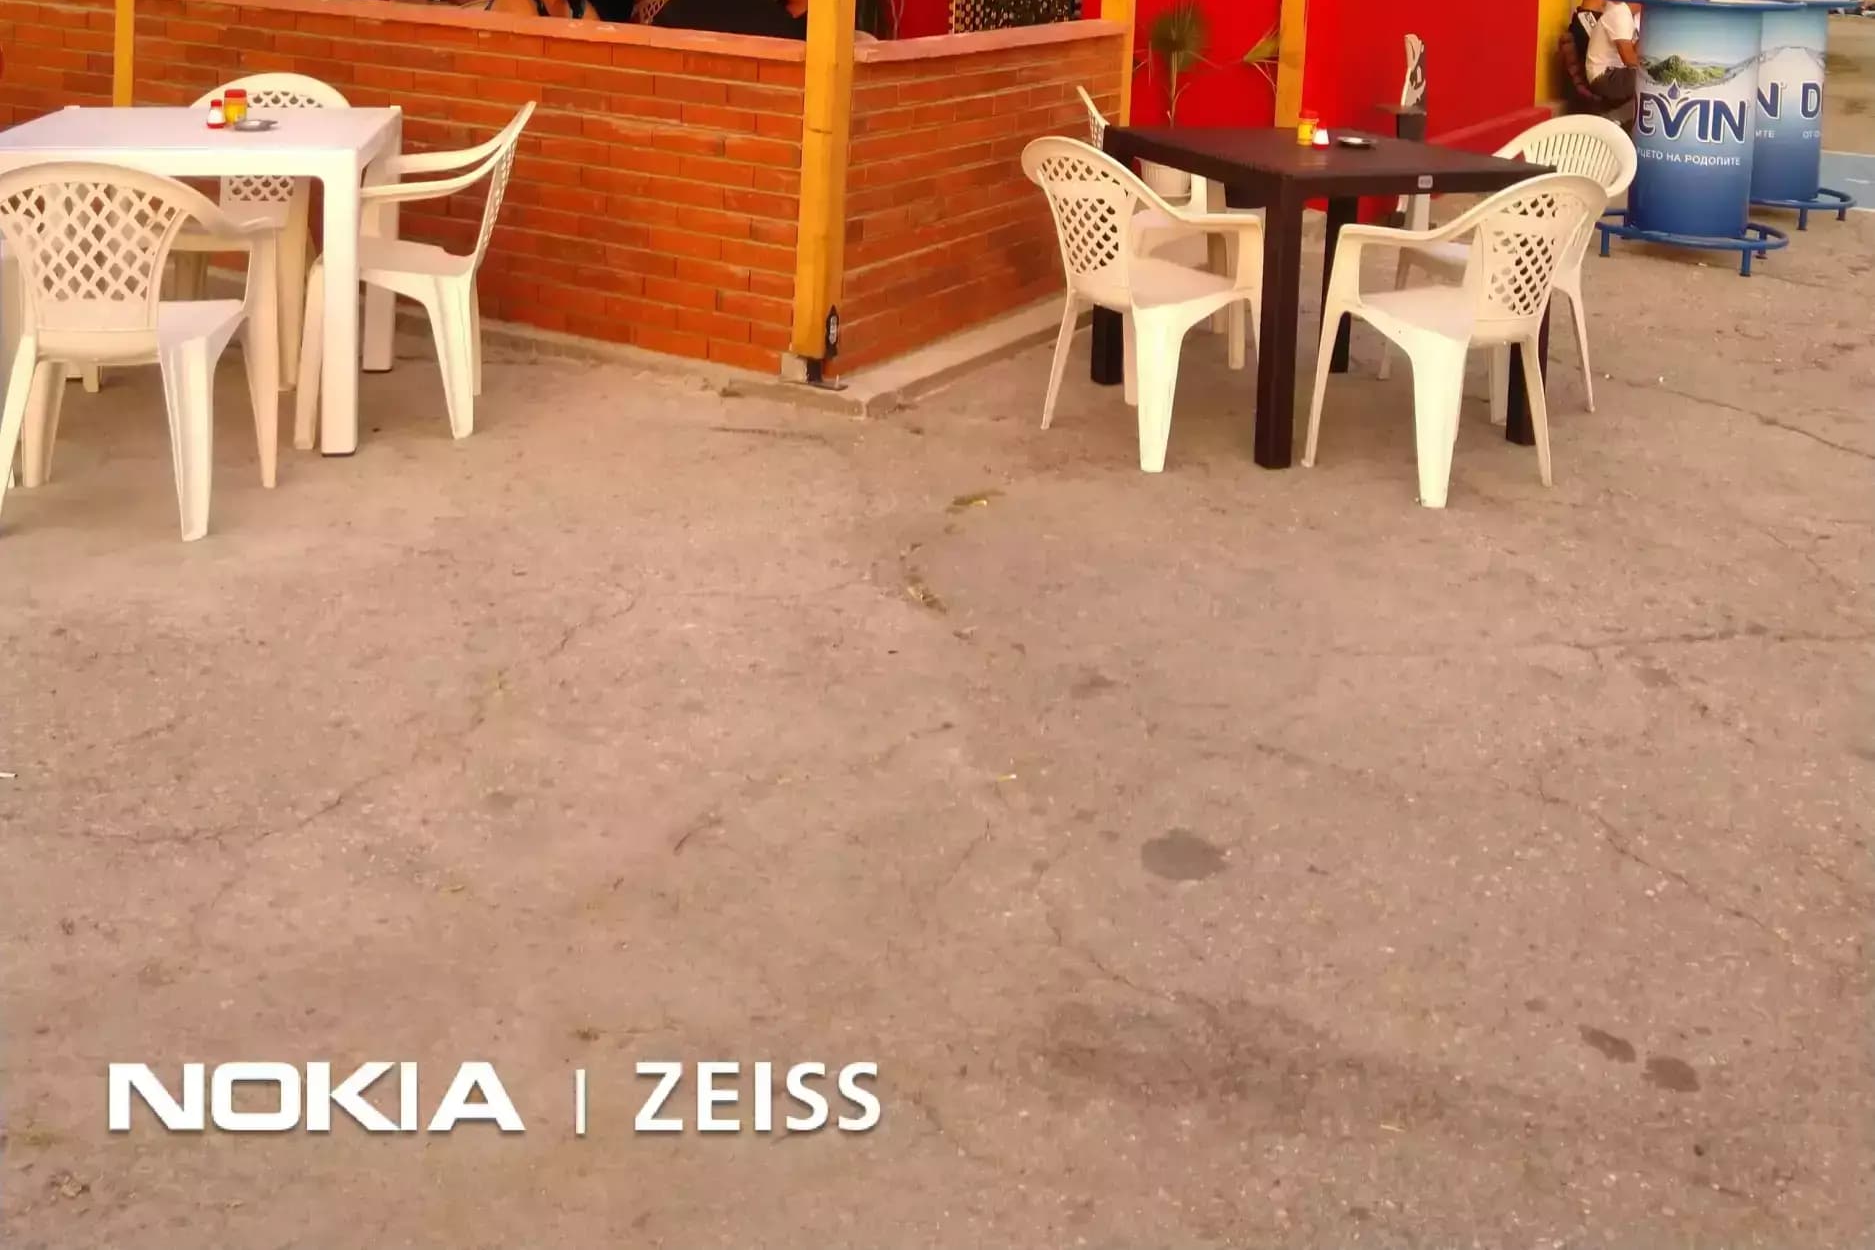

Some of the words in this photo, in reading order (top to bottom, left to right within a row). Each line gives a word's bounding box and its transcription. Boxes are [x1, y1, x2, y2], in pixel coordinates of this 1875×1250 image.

[1635, 91, 1747, 144] EVIN
[1800, 81, 1824, 120] D
[1666, 153, 1682, 163] НА
[1684, 154, 1741, 167] РОДОПИТЕ
